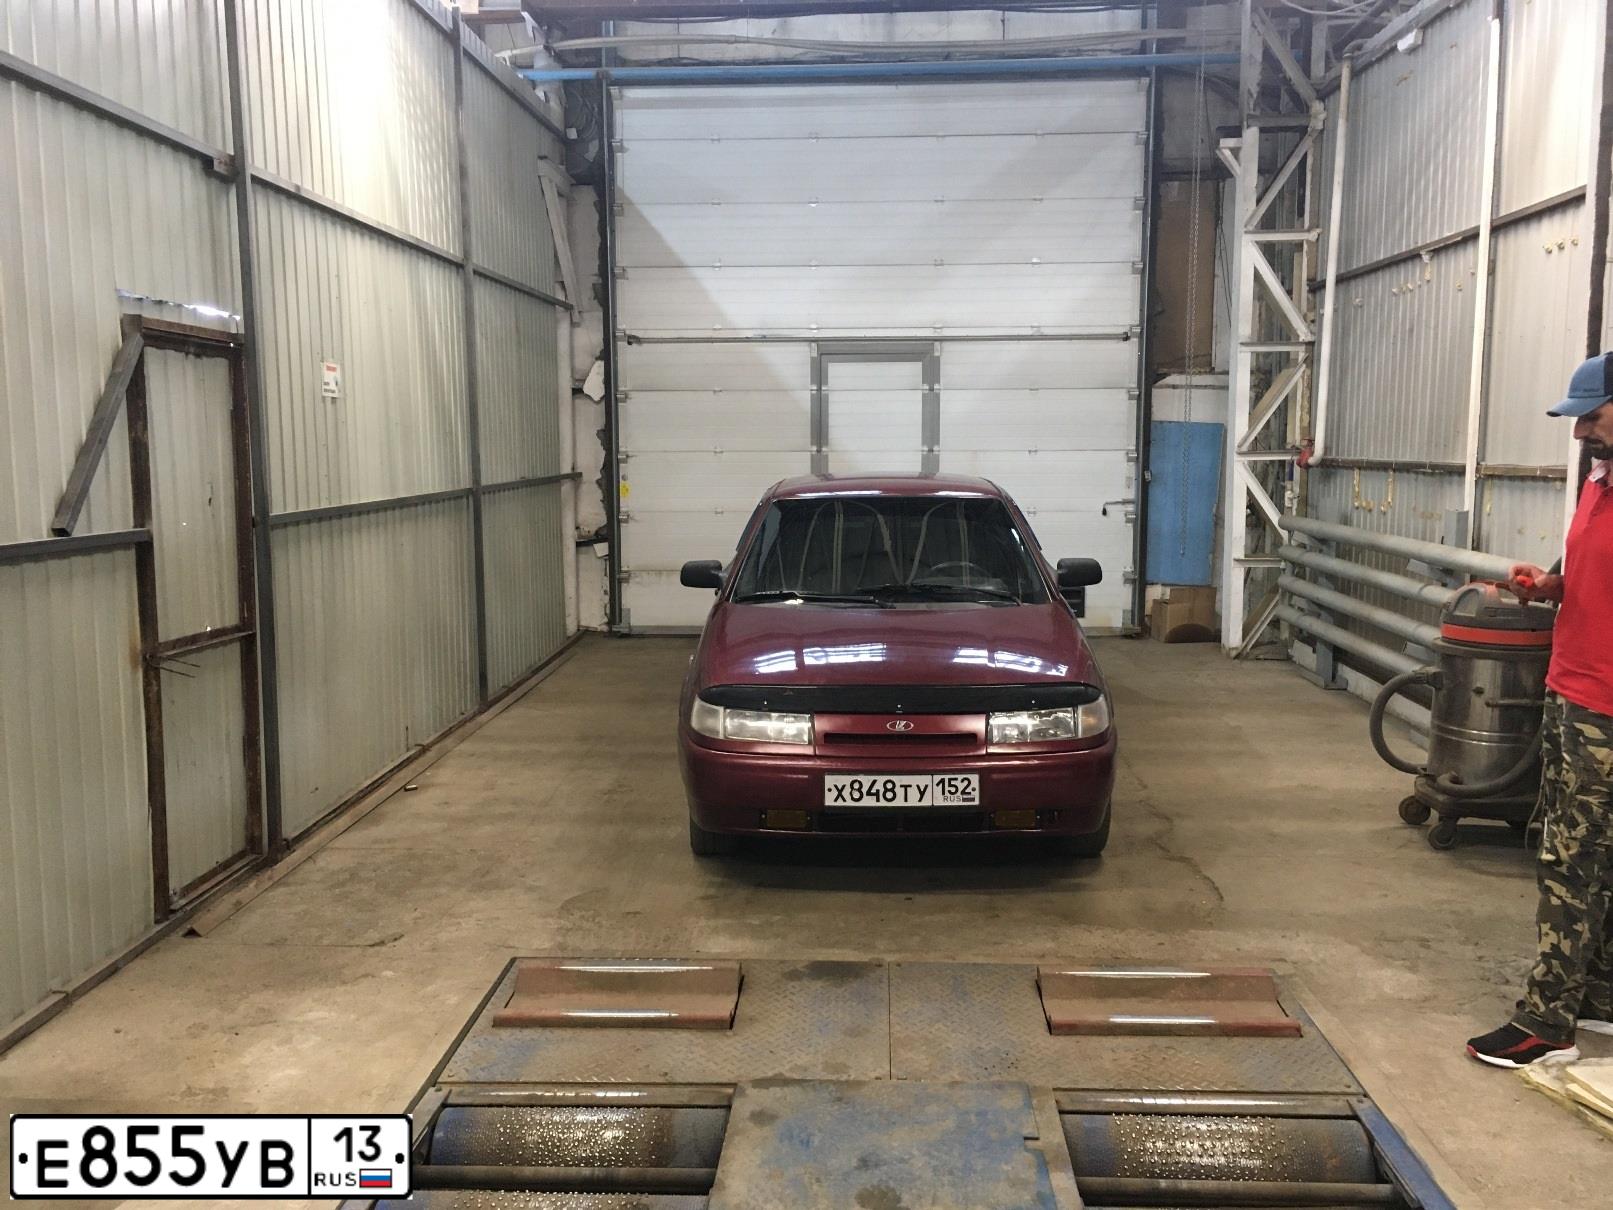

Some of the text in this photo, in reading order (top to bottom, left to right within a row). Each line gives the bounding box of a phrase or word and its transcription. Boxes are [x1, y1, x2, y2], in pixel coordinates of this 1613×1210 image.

[833, 779, 929, 802] X848TY
[936, 777, 972, 795] 152
[943, 795, 962, 803] RUS
